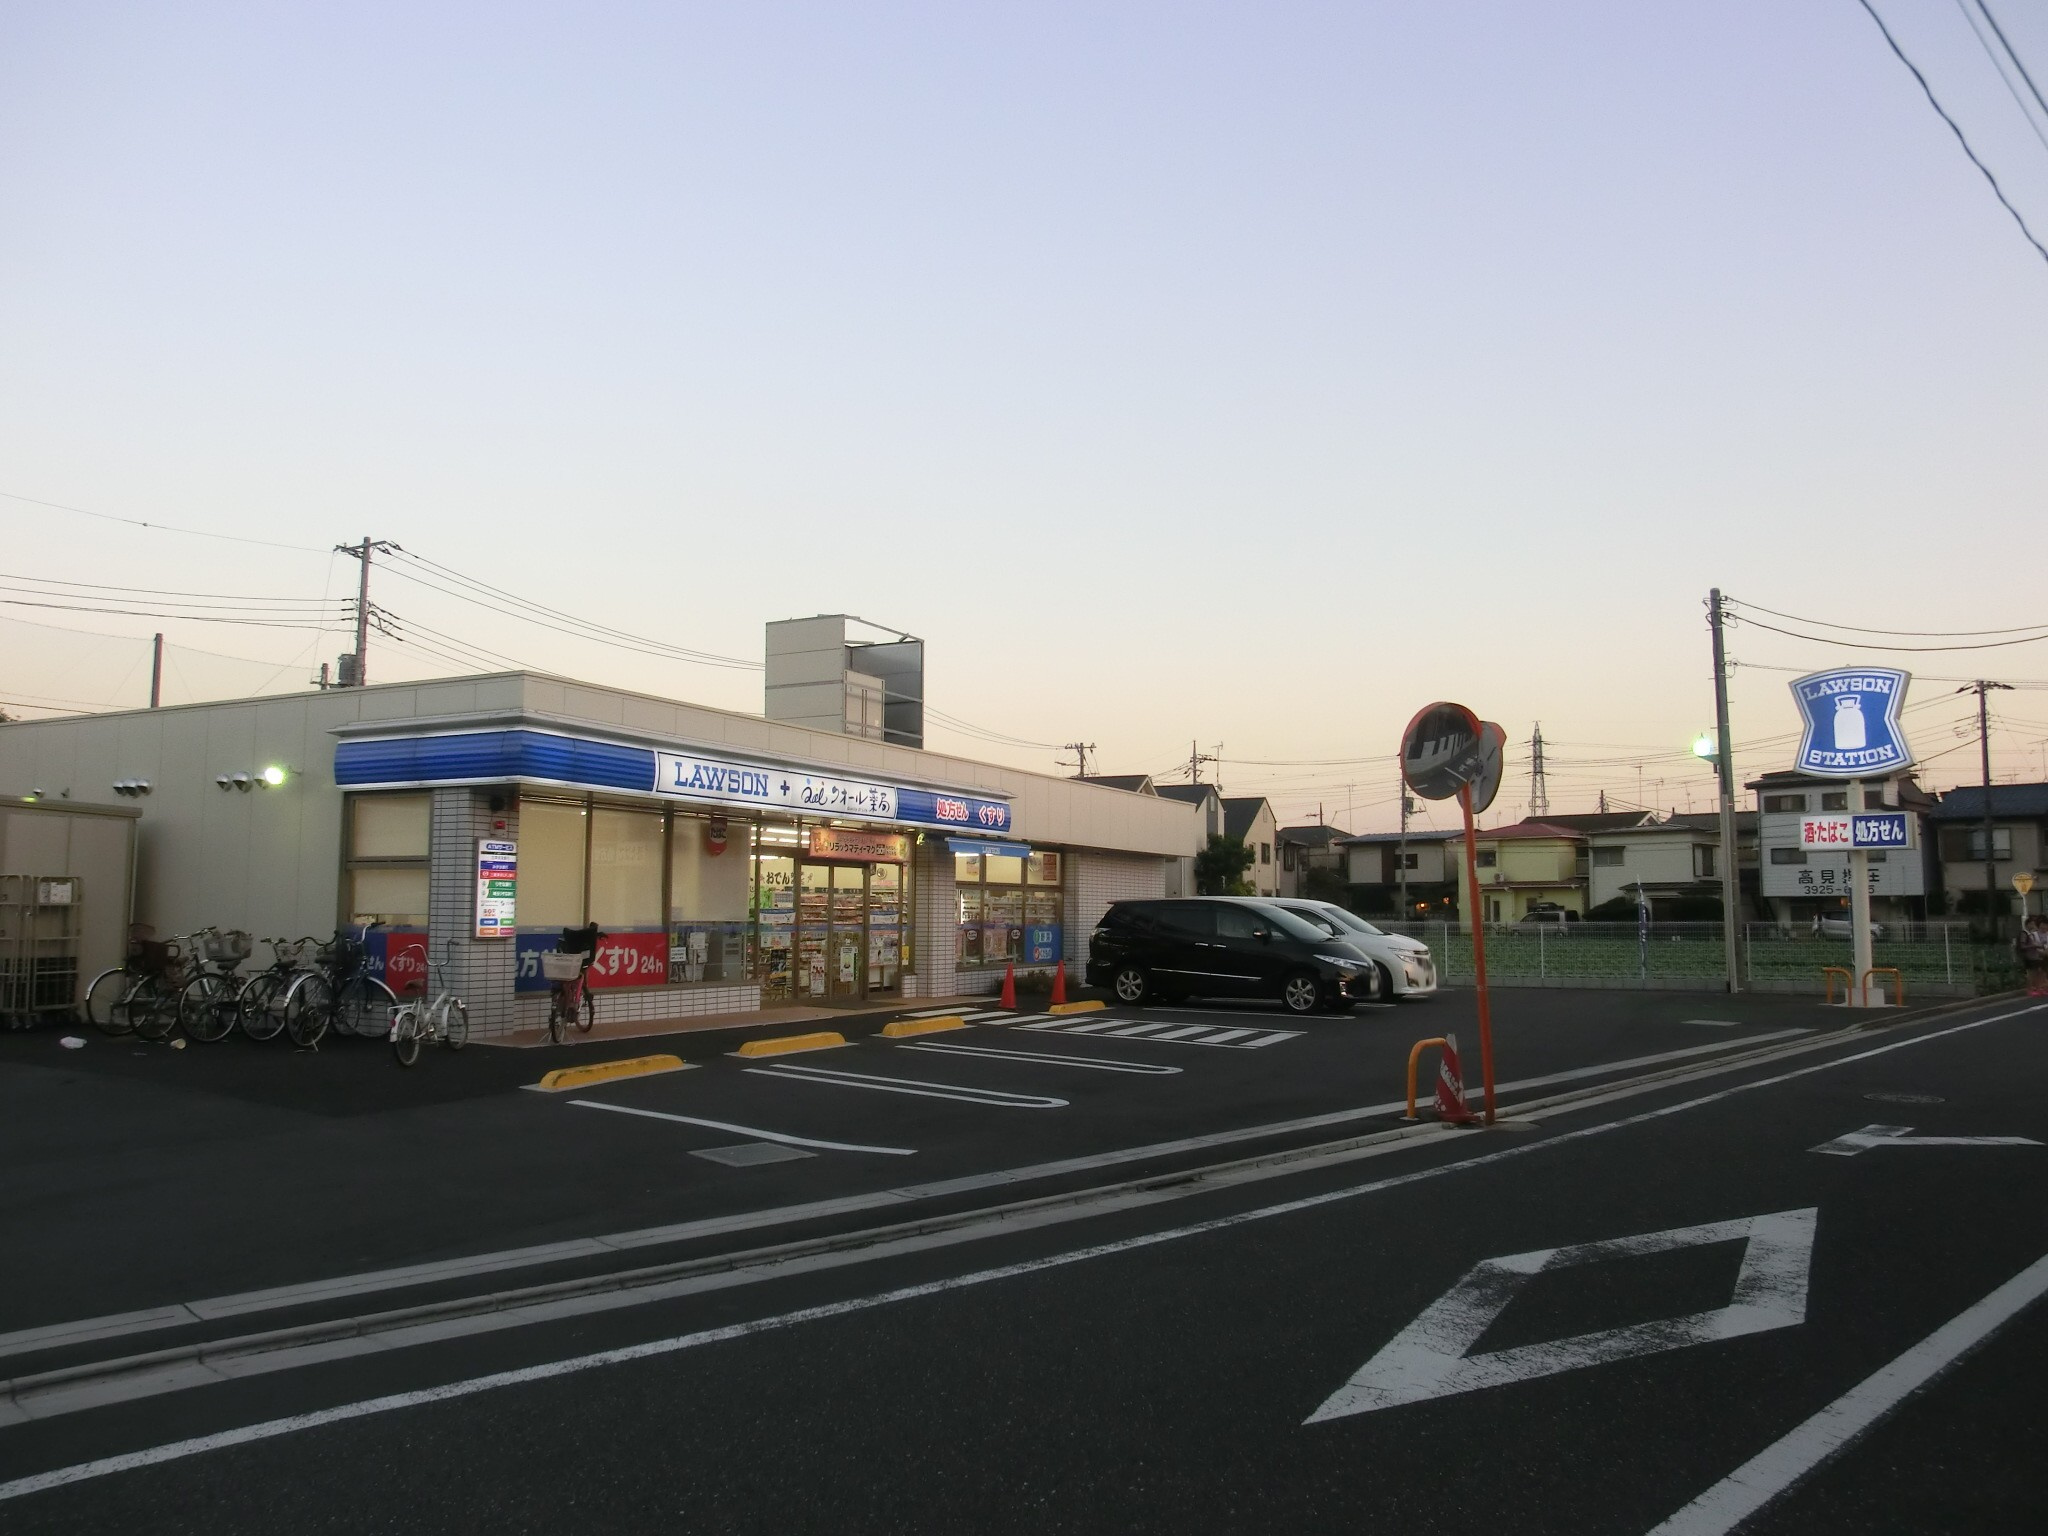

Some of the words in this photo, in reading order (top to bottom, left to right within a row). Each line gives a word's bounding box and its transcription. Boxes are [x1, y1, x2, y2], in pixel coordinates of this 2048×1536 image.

[1804, 677, 1892, 700] LAWSON
[1809, 744, 1895, 766] STATION
[674, 761, 769, 797] LAWSON
[831, 785, 891, 814] クオール薬局
[936, 797, 970, 822] 処方せん
[978, 805, 1005, 826] くすり
[1855, 820, 1904, 843] 処方せん
[389, 955, 415, 973] くすり
[593, 945, 638, 976] くすり
[640, 954, 664, 975] 24h
